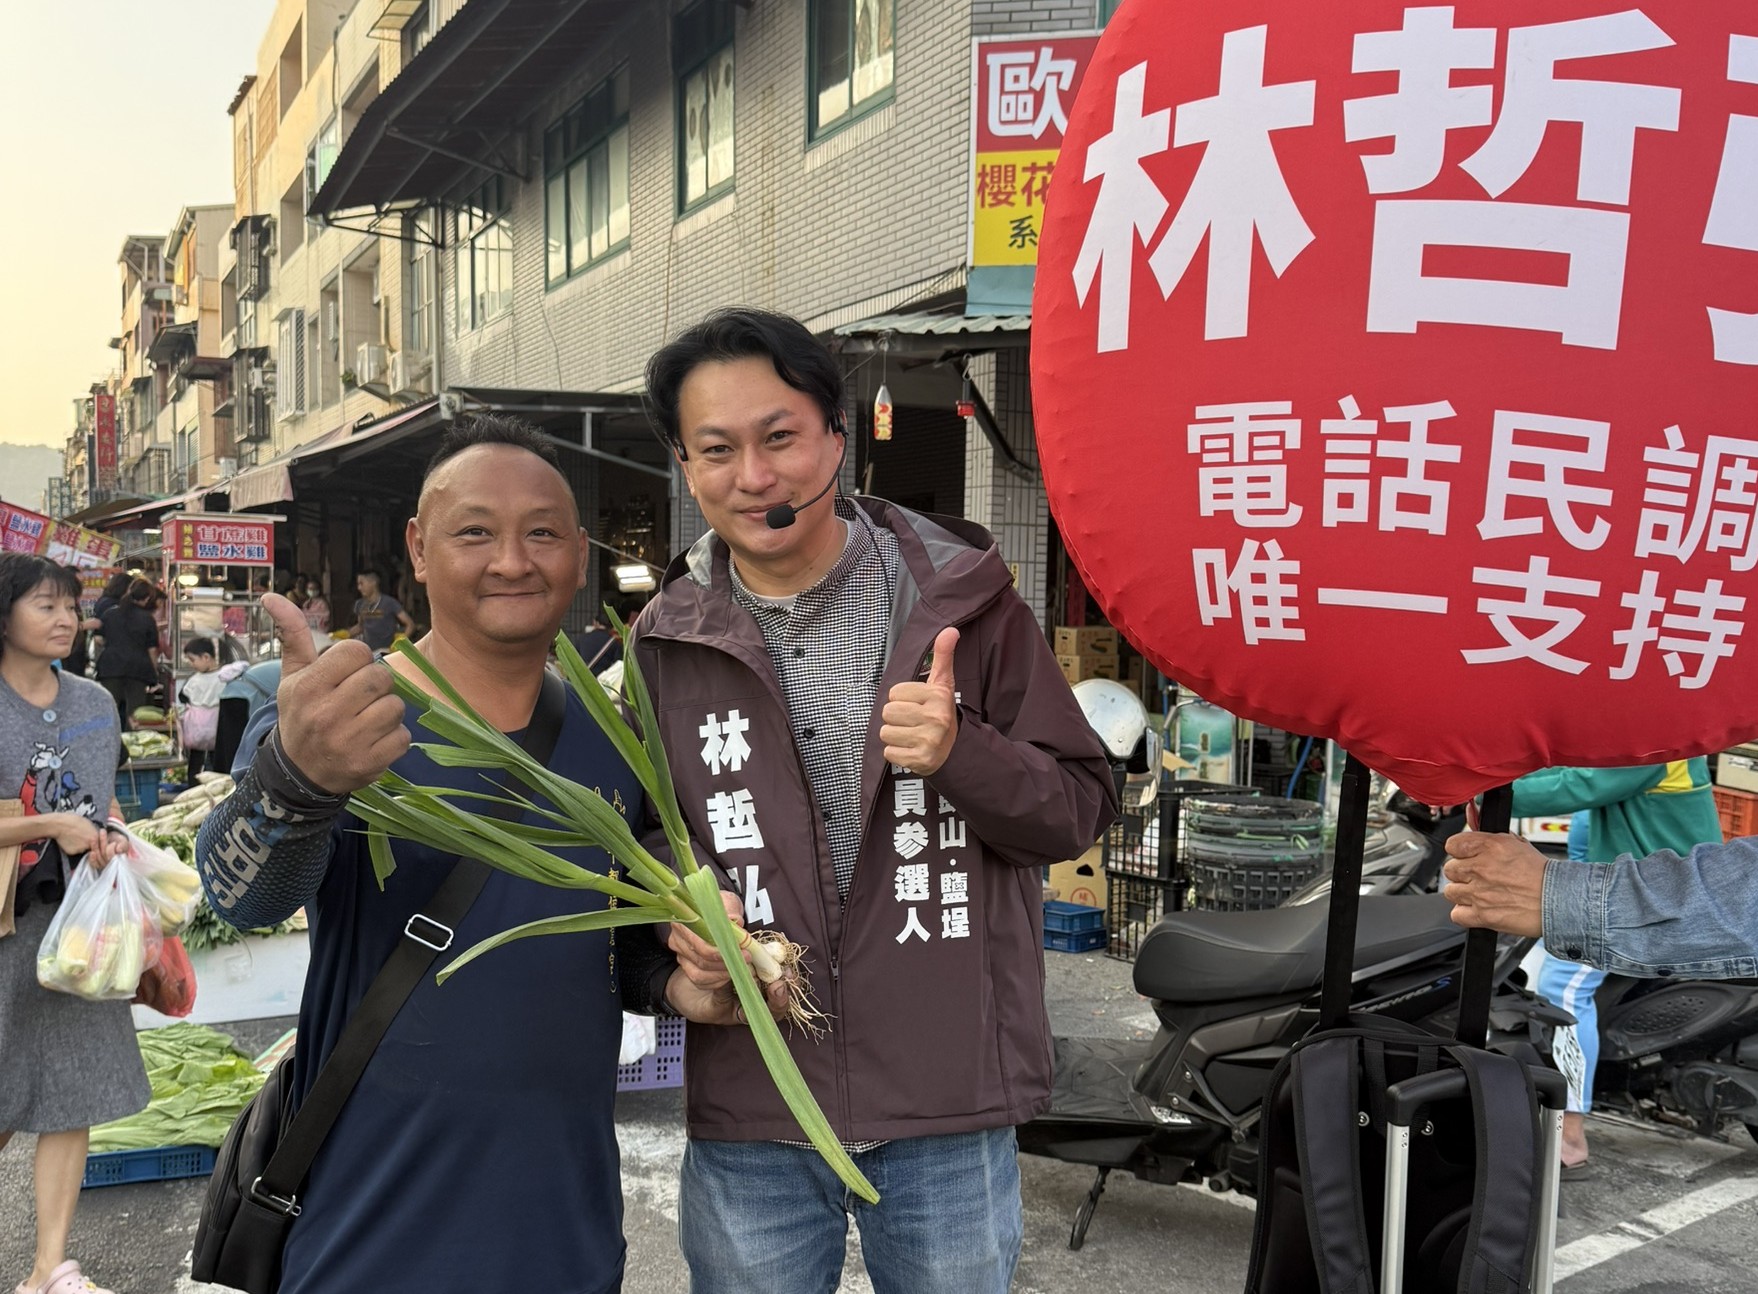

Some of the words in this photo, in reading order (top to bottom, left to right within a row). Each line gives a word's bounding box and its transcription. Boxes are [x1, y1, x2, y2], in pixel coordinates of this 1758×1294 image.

[986, 46, 1077, 140] 歐
[977, 161, 1056, 209] 櫻花
[1072, 4, 1758, 366] 林哲
[1008, 215, 1038, 249] 系
[1187, 394, 1758, 571] 電話民調
[197, 524, 268, 543] 甘蔗雞
[197, 542, 268, 560] 鹽水雞
[1191, 538, 1746, 689] 唯一支持
